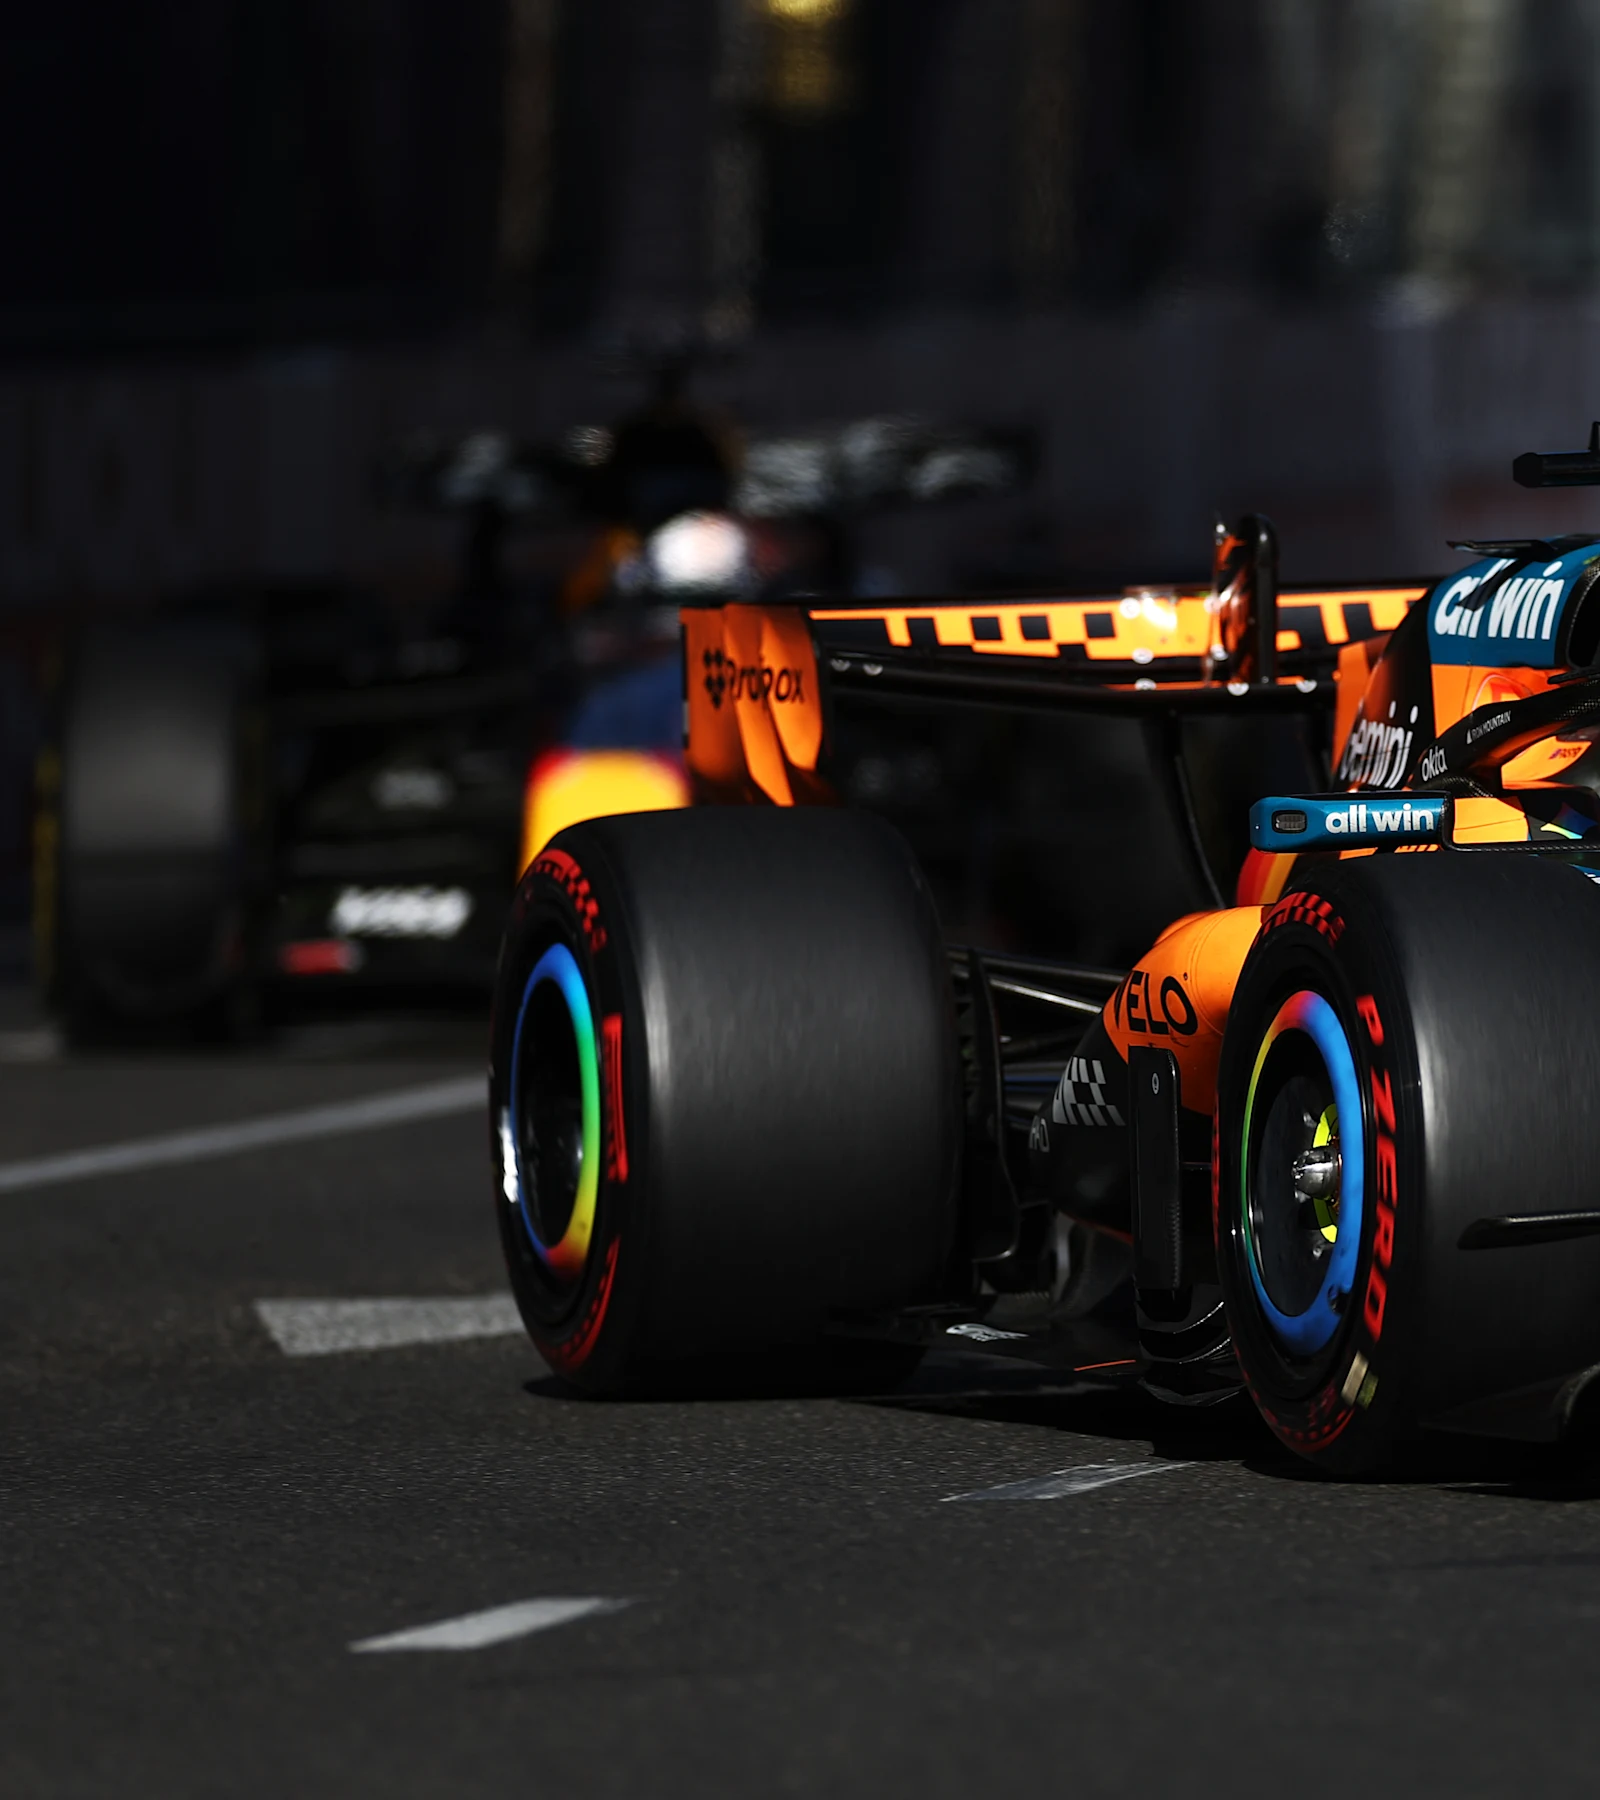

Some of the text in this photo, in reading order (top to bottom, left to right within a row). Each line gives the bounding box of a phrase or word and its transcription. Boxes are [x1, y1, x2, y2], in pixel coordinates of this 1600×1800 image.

[1434, 558, 1565, 640] all win
[1483, 709, 1512, 734] MOUNTAIN
[1421, 745, 1449, 782] okta
[1325, 803, 1435, 834] all win
[1110, 970, 1198, 1036] VELO
[1356, 994, 1399, 1342] P ZERO
